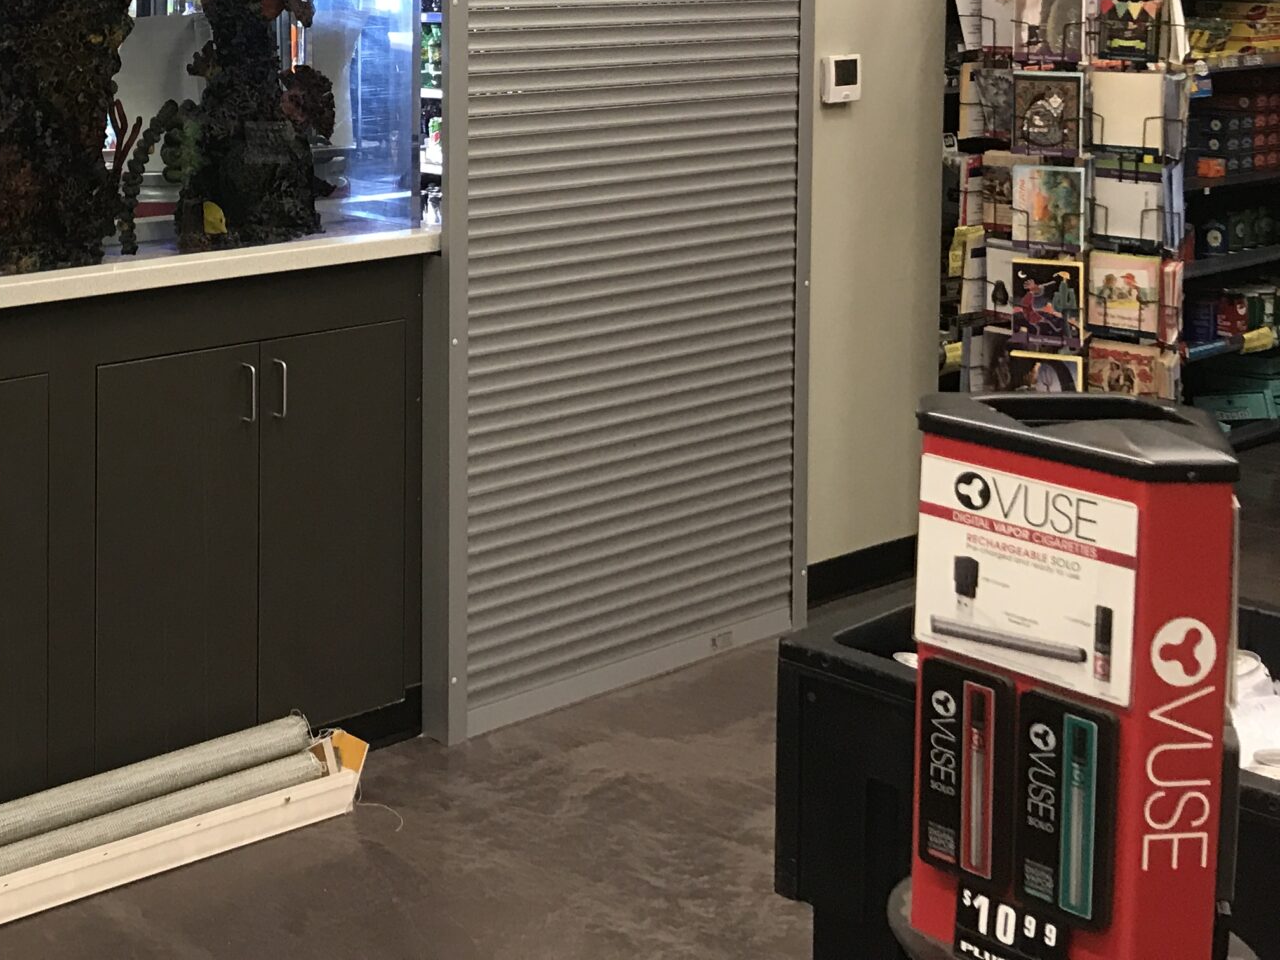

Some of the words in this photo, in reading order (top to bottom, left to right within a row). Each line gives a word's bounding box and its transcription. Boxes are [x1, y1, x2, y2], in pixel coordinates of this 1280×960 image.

[952, 511, 991, 530] DIGITAL
[992, 520, 1031, 541] VAPOR
[1031, 532, 1099, 559] CIGARETTES
[992, 476, 1099, 543] VUSE
[966, 532, 1048, 563] RECHARGEABLE
[1050, 555, 1081, 572] SOLO
[930, 717, 957, 784] VUSE
[1141, 685, 1216, 872] VUSE
[1027, 751, 1056, 821] VUSE
